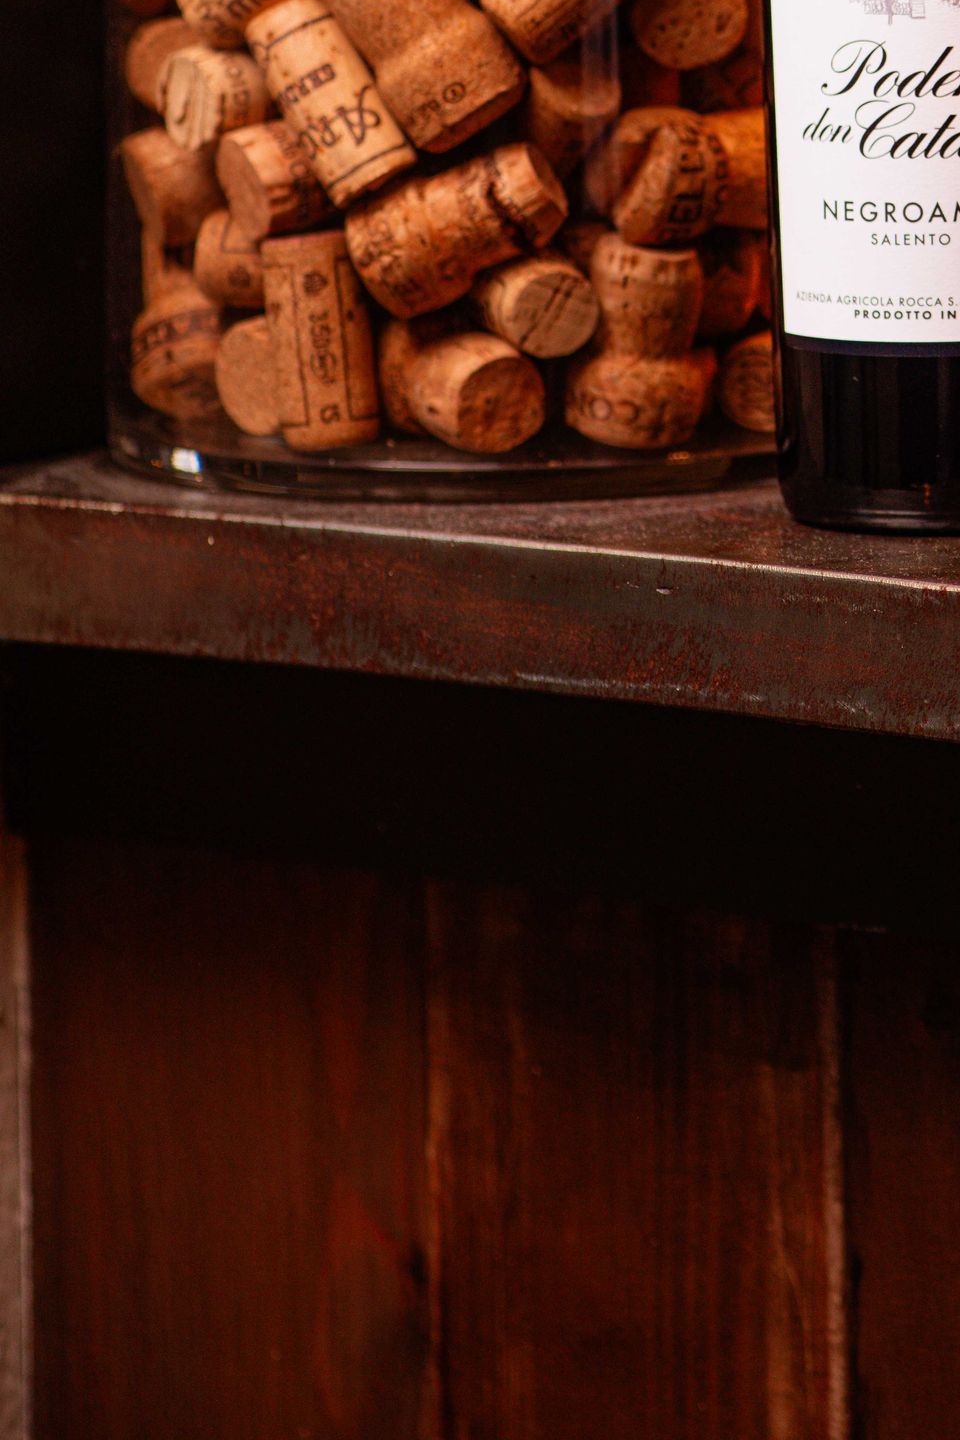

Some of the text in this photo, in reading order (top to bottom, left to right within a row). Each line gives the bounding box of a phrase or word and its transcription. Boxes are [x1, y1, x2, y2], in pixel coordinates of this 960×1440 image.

[802, 107, 853, 145] don
[870, 233, 951, 246] SALENTO
[796, 290, 832, 304] AZIENDA
[836, 295, 894, 308] AGRICOLA
[899, 296, 942, 308] ROCCA
[854, 309, 932, 320] PRODOTTO
[941, 309, 957, 320] IN
